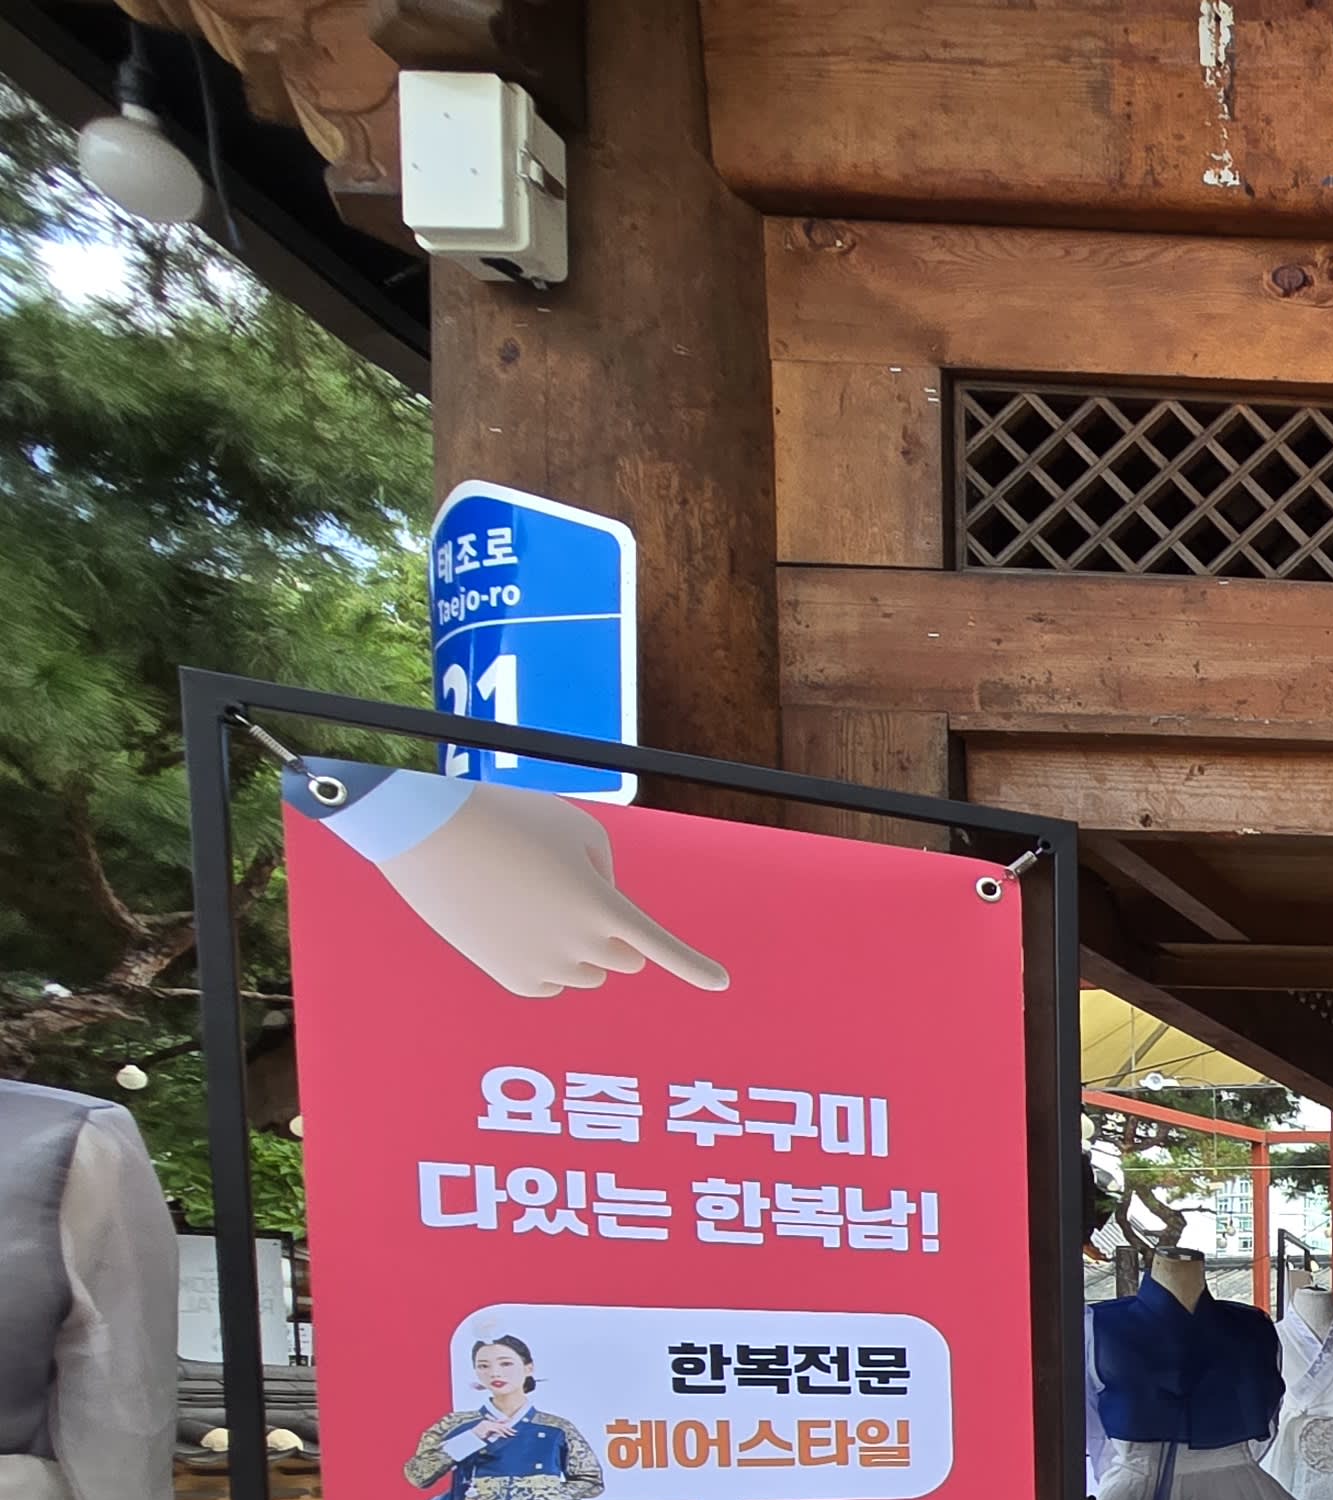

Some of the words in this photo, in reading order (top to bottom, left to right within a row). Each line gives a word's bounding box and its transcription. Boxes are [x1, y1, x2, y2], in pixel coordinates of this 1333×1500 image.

[437, 527, 518, 584] 태조로
[438, 584, 521, 626] Taejo-ro
[442, 654, 518, 777] 21
[476, 1065, 645, 1144] 요즘
[665, 1079, 890, 1159] 추구미
[417, 1160, 674, 1242] 다있는
[691, 1176, 941, 1254] 한복남!
[667, 1341, 912, 1397] 한복전문
[605, 1418, 911, 1470] 헤어스타일
